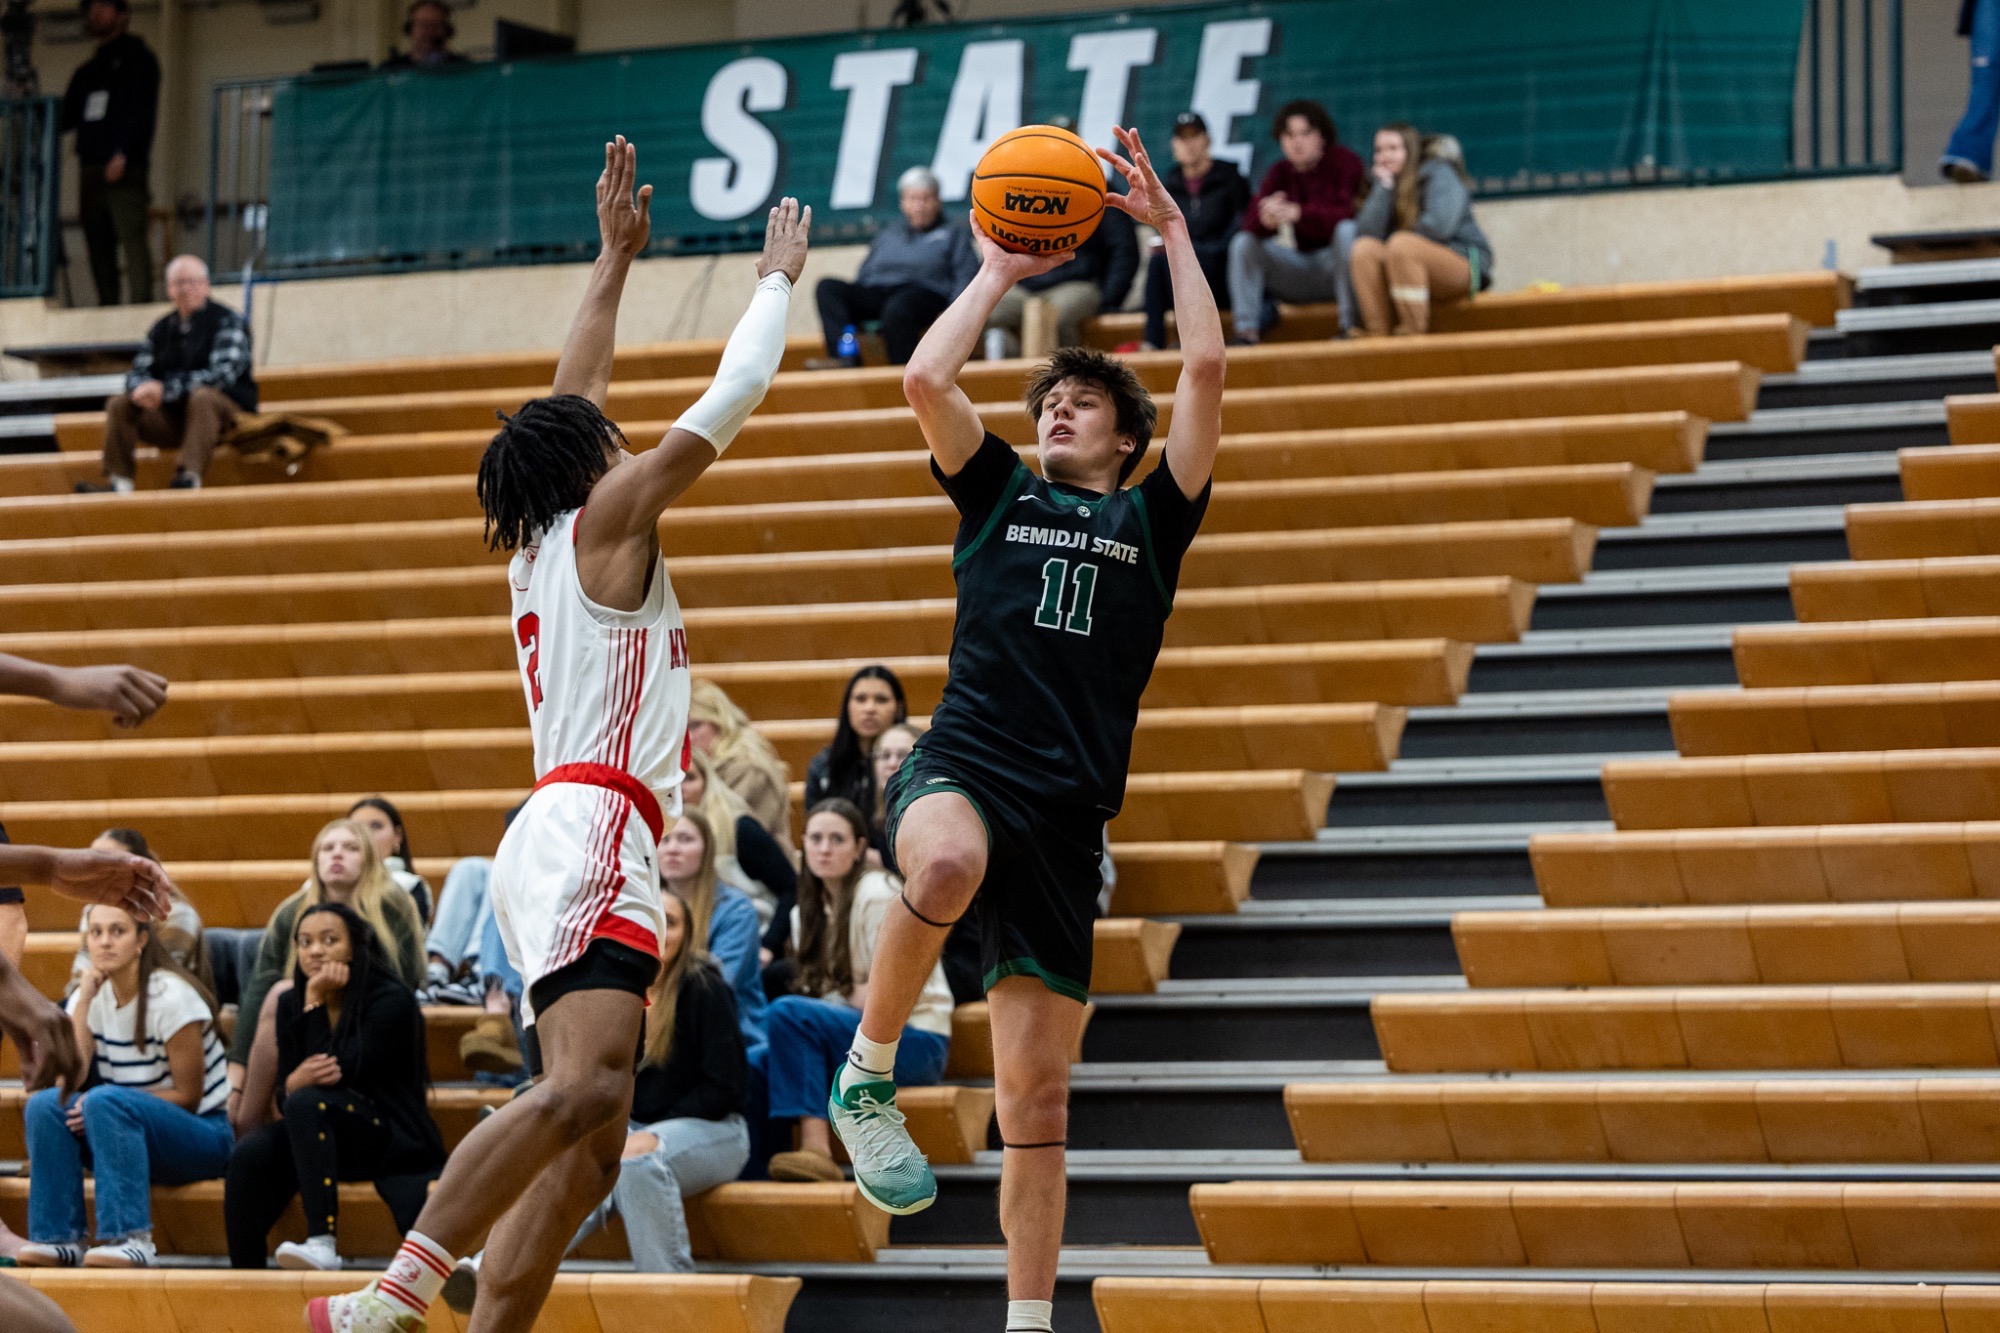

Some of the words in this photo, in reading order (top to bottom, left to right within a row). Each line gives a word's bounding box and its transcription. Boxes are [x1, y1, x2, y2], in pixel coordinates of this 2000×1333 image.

[690, 18, 1272, 221] STATE
[1005, 192, 1069, 215] NCAA
[991, 222, 1078, 252] Wilson
[1005, 524, 1088, 550] BEMIDJI
[1091, 537, 1139, 565] STATE
[1034, 557, 1099, 636] 11
[517, 611, 543, 713] 2
